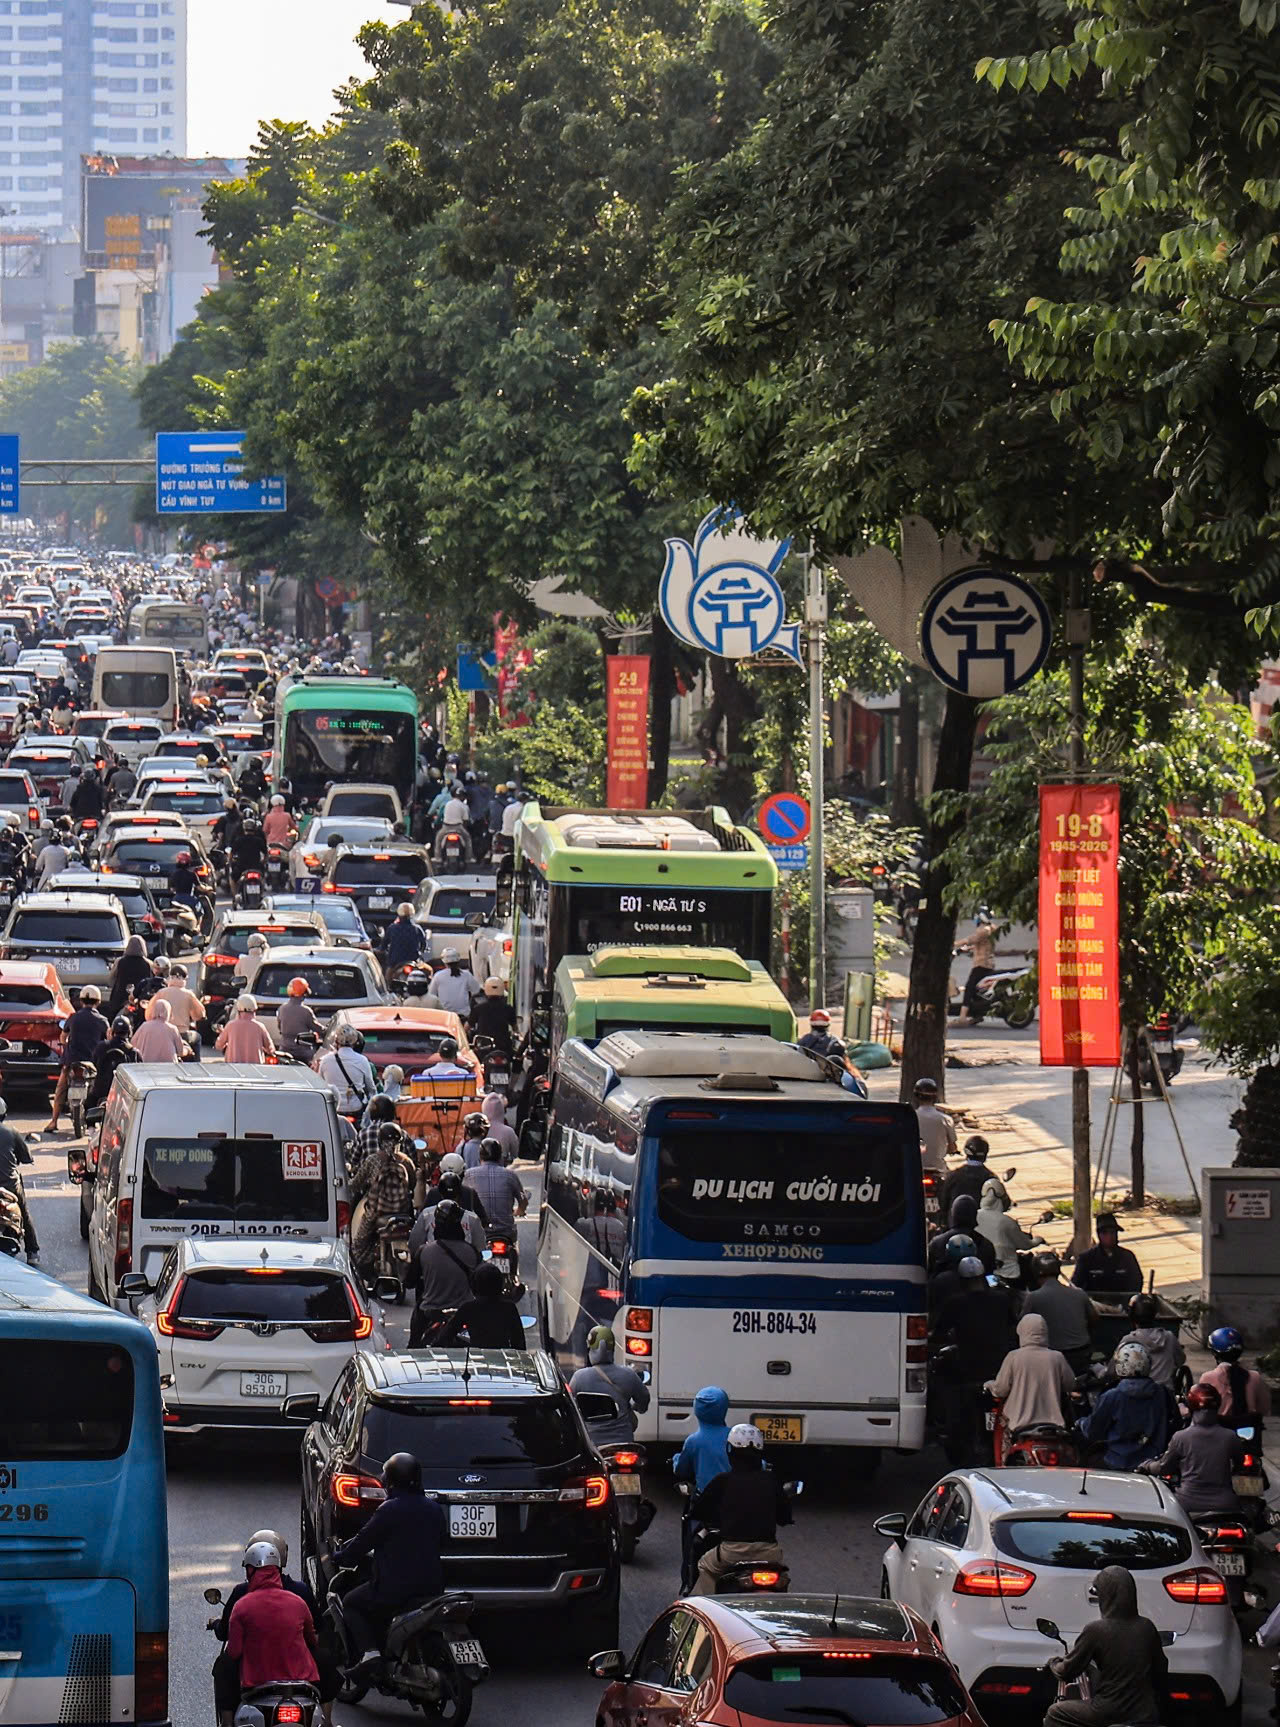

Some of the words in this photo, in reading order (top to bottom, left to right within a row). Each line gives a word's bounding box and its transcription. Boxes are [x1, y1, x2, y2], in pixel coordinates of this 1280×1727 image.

[1, 465, 13, 475] km
[1, 481, 13, 491] km
[178, 480, 196, 490] GIAO
[268, 479, 281, 489] km
[1, 498, 13, 508] km
[268, 495, 281, 505] km
[1056, 814, 1102, 837] 19-8
[1050, 840, 1108, 852] 1945-2026
[620, 896, 642, 912] E01
[652, 898, 677, 912] NGÃ
[680, 899, 695, 912] TƯ
[727, 1179, 774, 1203] LỊCH
[786, 1175, 837, 1201] CƯỚI
[841, 1176, 881, 1202] HỎI
[744, 1224, 821, 1236] SAMCO
[254, 1374, 273, 1384] 30G
[245, 1385, 282, 1395] 953.07
[767, 1418, 788, 1429] 29H
[461, 1506, 485, 1520] 30F
[452, 1522, 495, 1536] 939.97
